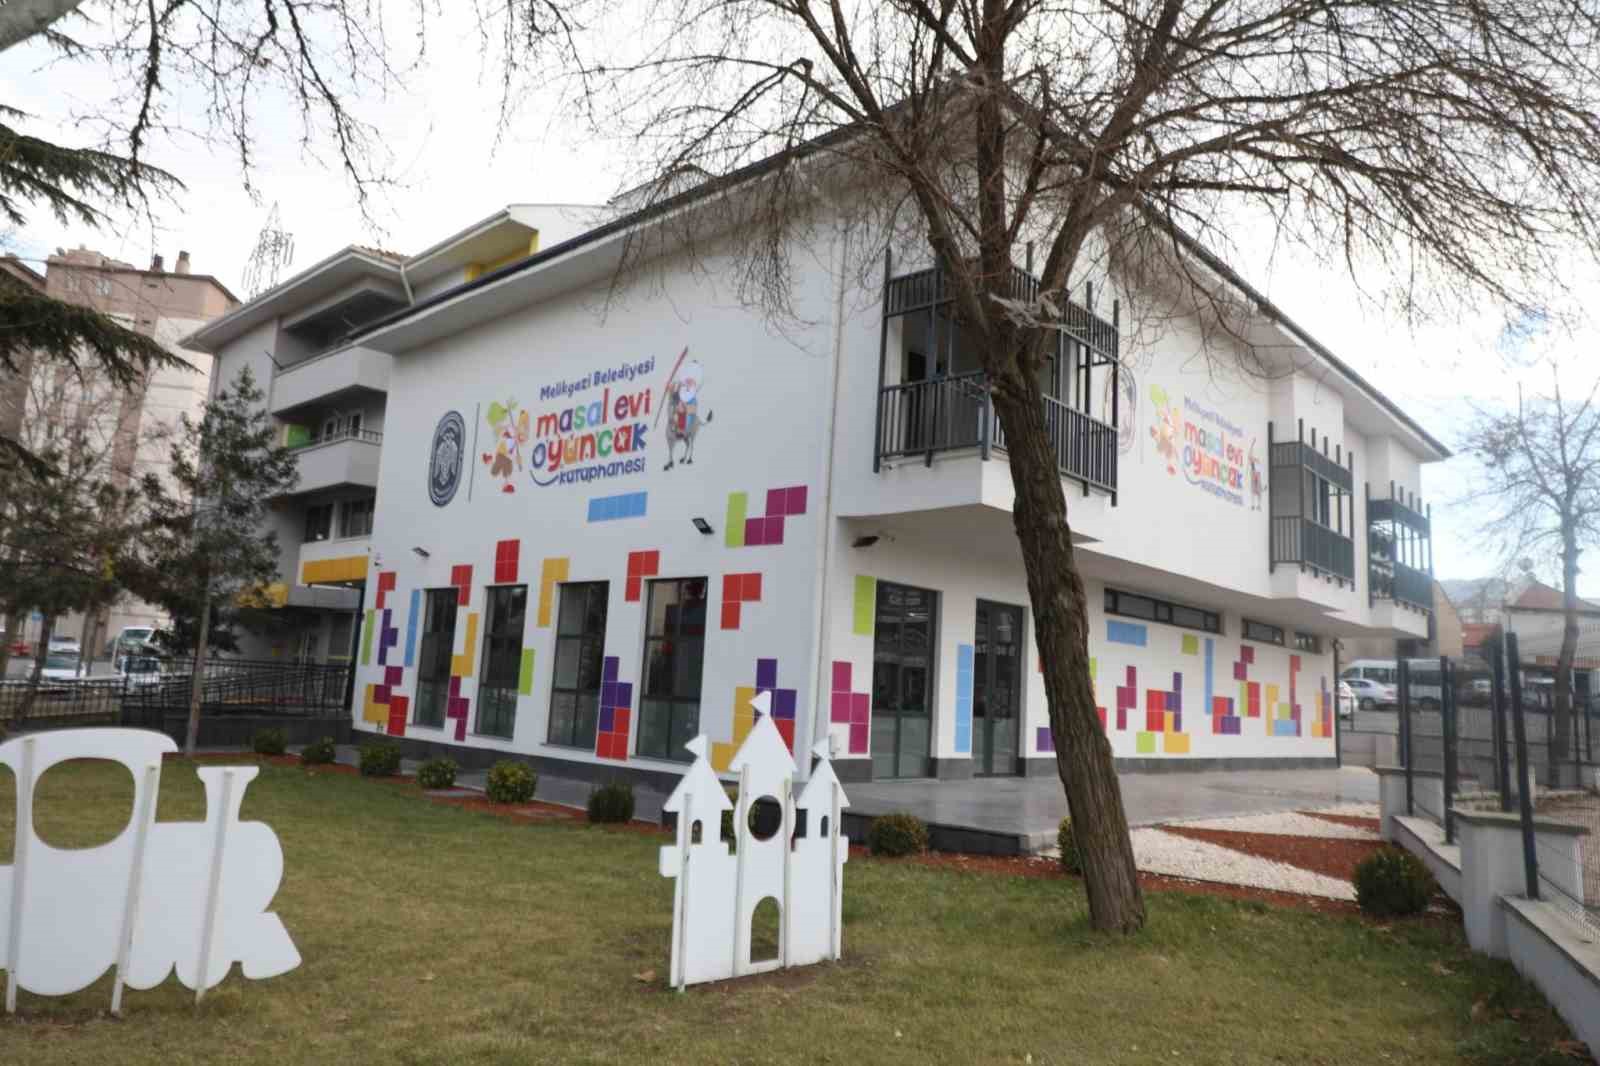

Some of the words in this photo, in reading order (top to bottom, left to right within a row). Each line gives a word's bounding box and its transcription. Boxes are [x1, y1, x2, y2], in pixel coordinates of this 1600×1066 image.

[540, 373, 592, 401] Melikgazi
[593, 355, 655, 387] Belediyesi
[536, 387, 609, 438] masal
[614, 388, 651, 421] evi
[532, 422, 648, 473] oyuncak
